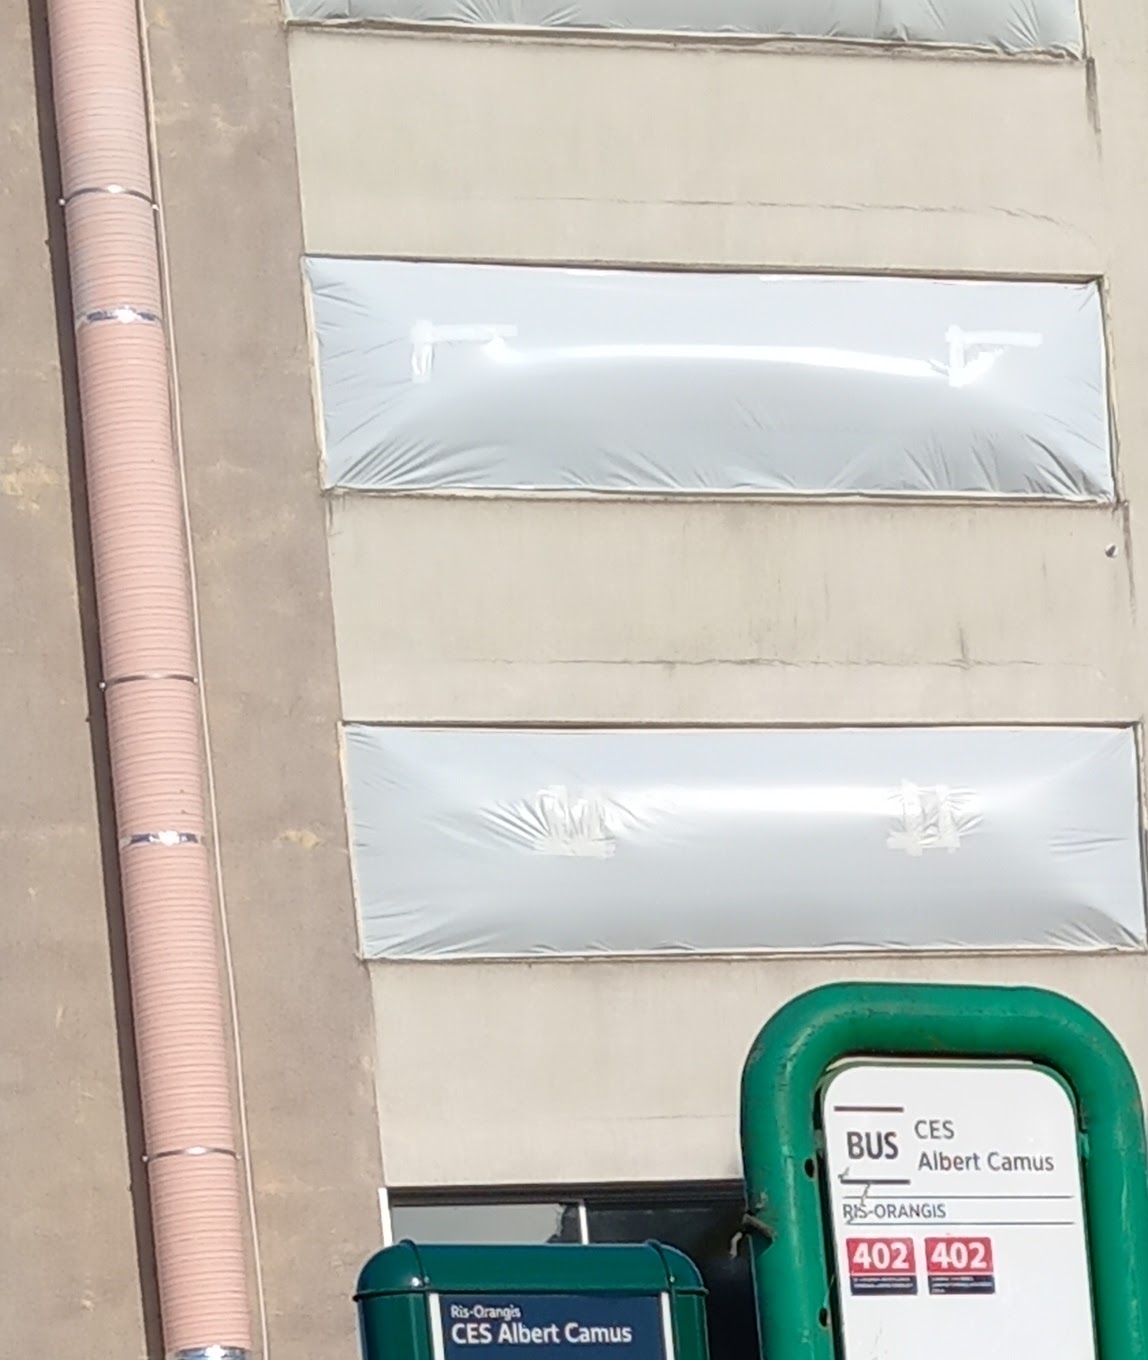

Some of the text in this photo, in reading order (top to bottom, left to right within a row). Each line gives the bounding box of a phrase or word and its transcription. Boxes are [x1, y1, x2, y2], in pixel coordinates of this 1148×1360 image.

[914, 1120, 955, 1140] CES
[847, 1131, 899, 1160] BUS
[918, 1151, 1055, 1171] Albert Camus
[842, 1203, 947, 1219] RIS-ORANGIS
[853, 1242, 987, 1269] 402 402
[451, 1304, 521, 1321] Ris-Orangis
[451, 1323, 632, 1344] CES Albert Camus
